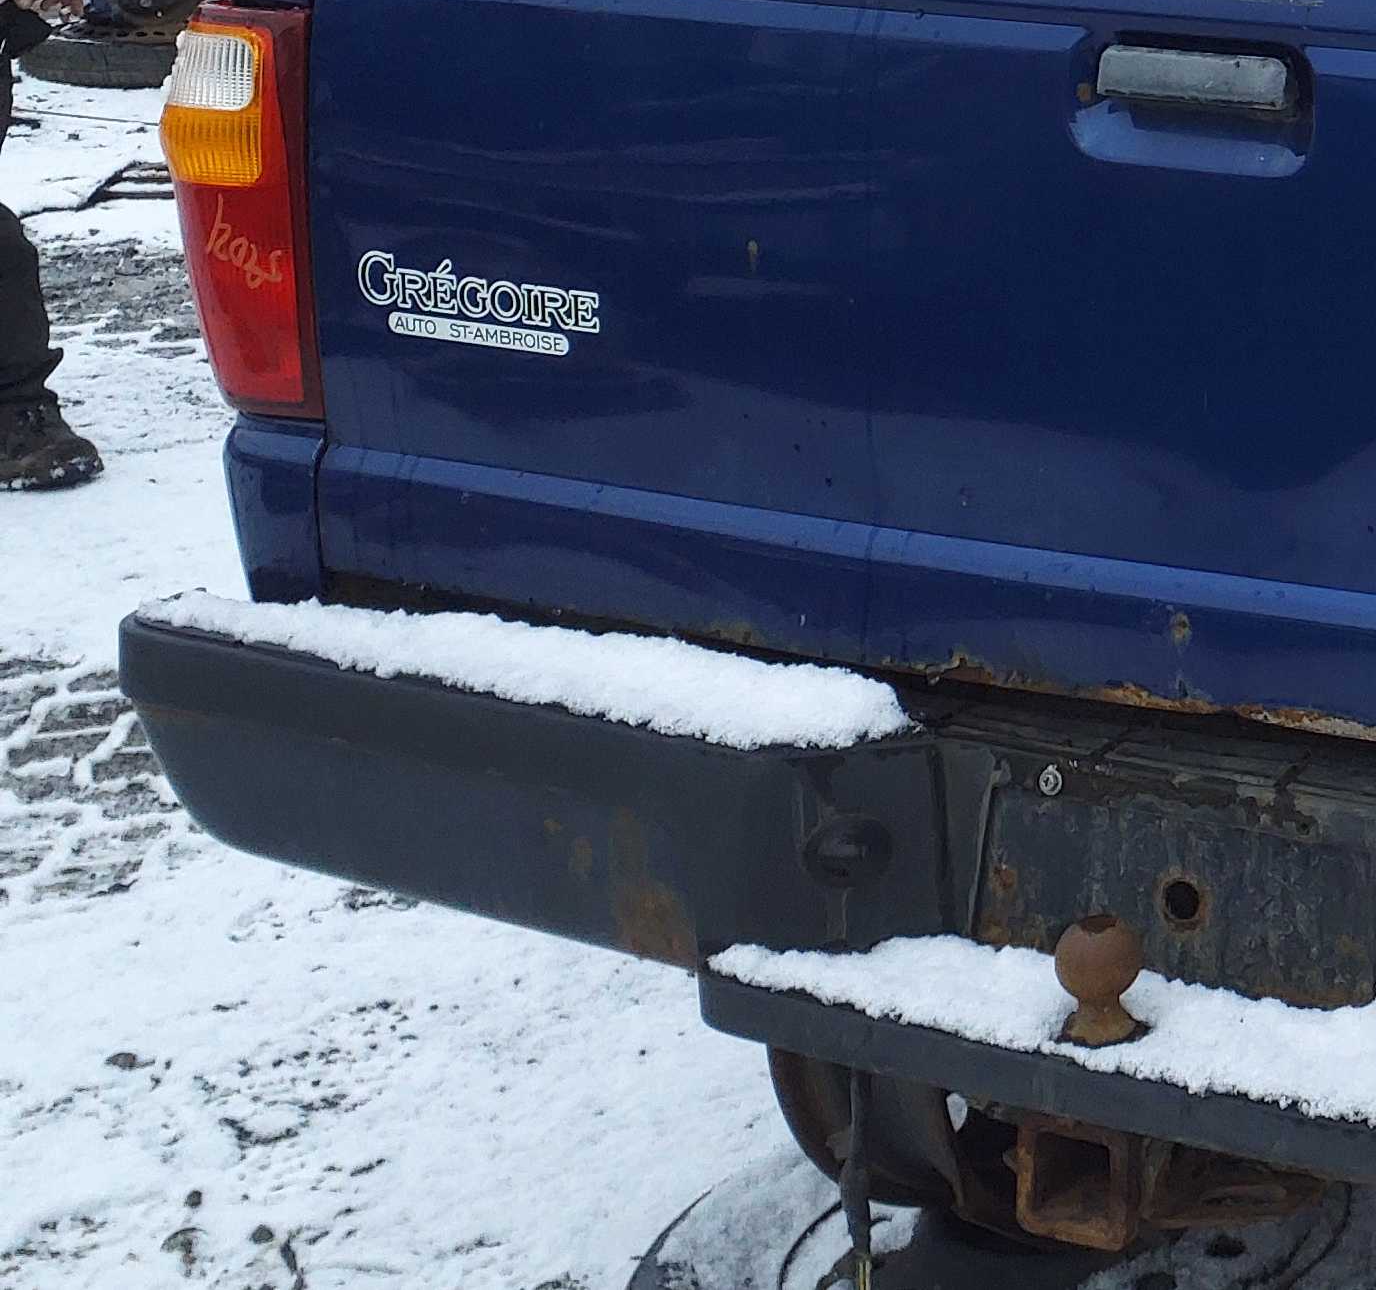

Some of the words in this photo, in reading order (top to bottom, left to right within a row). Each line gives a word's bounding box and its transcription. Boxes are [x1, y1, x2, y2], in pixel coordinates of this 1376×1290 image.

[357, 250, 600, 334] GRÉGOIRE
[394, 315, 437, 336] AUTO
[449, 323, 564, 353] ST-AMBROISE
